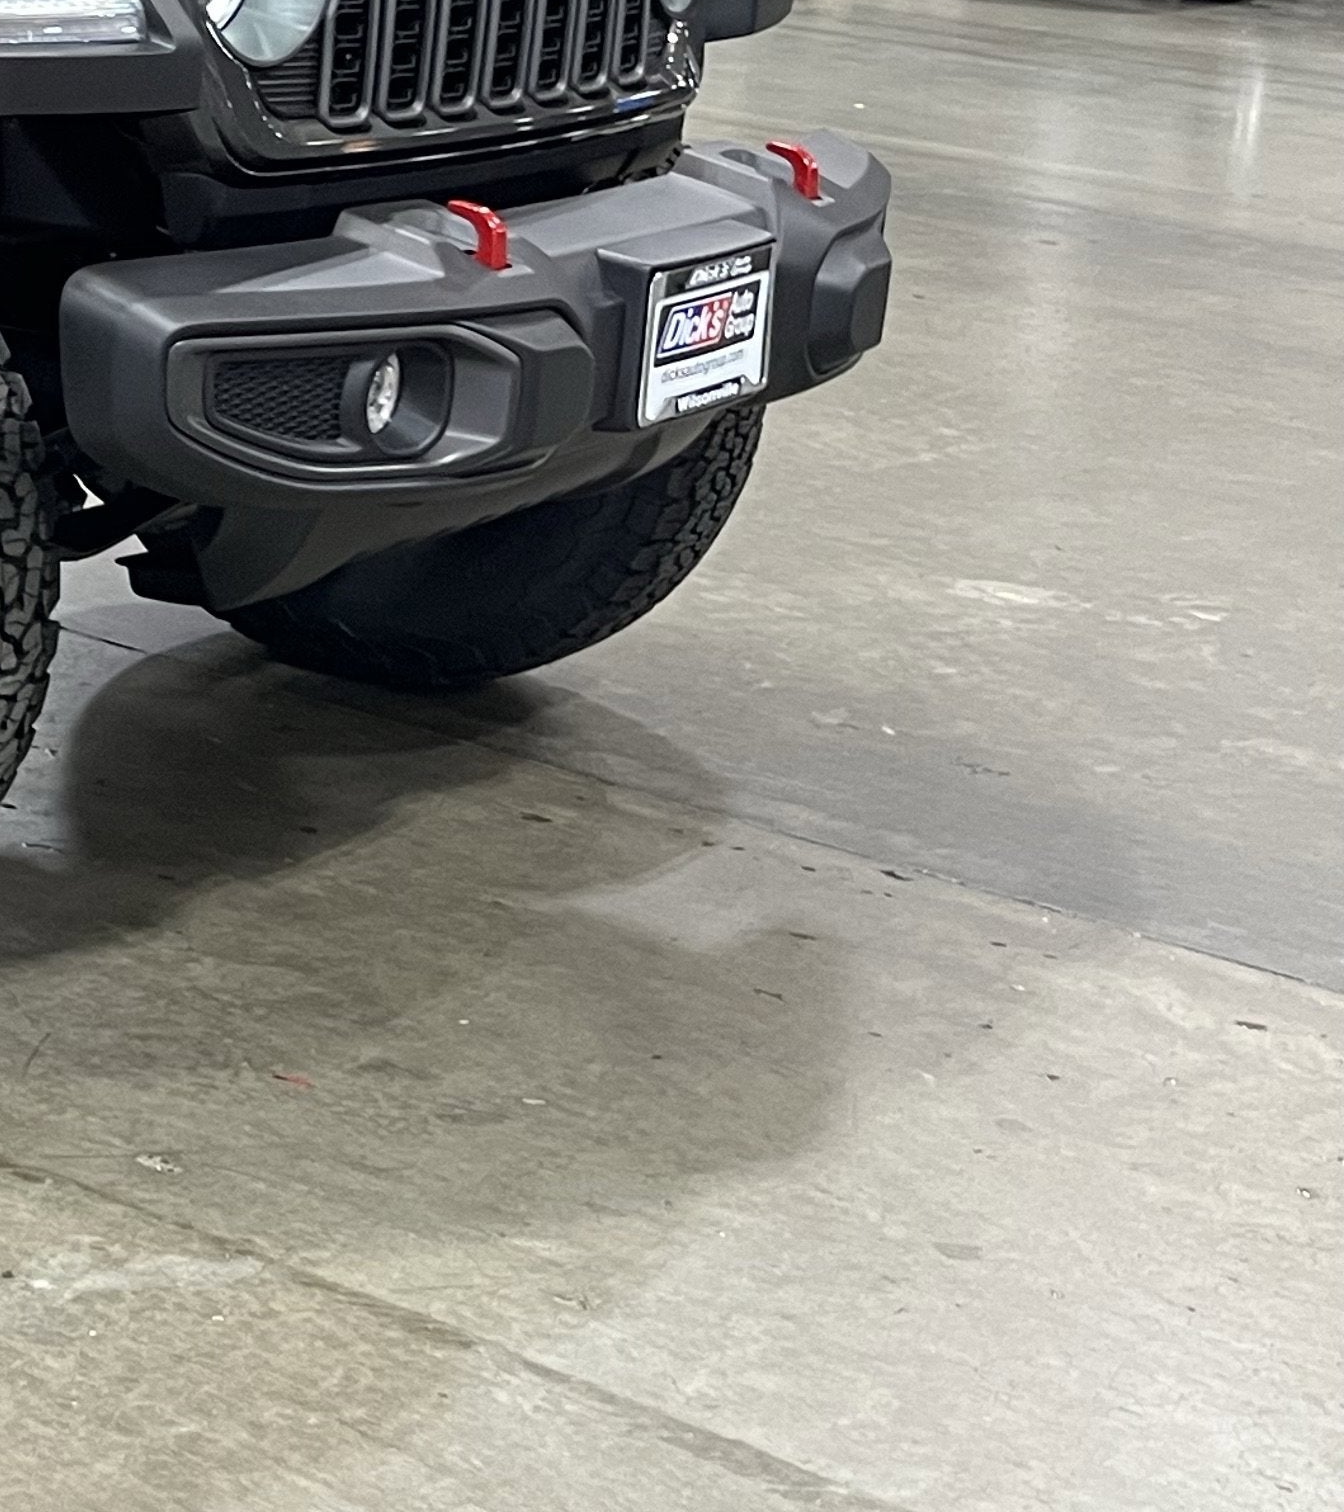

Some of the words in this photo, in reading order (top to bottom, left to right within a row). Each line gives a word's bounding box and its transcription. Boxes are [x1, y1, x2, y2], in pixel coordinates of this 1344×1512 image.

[732, 289, 754, 314] Auto
[662, 300, 730, 350] Dick's
[724, 313, 754, 339] Group
